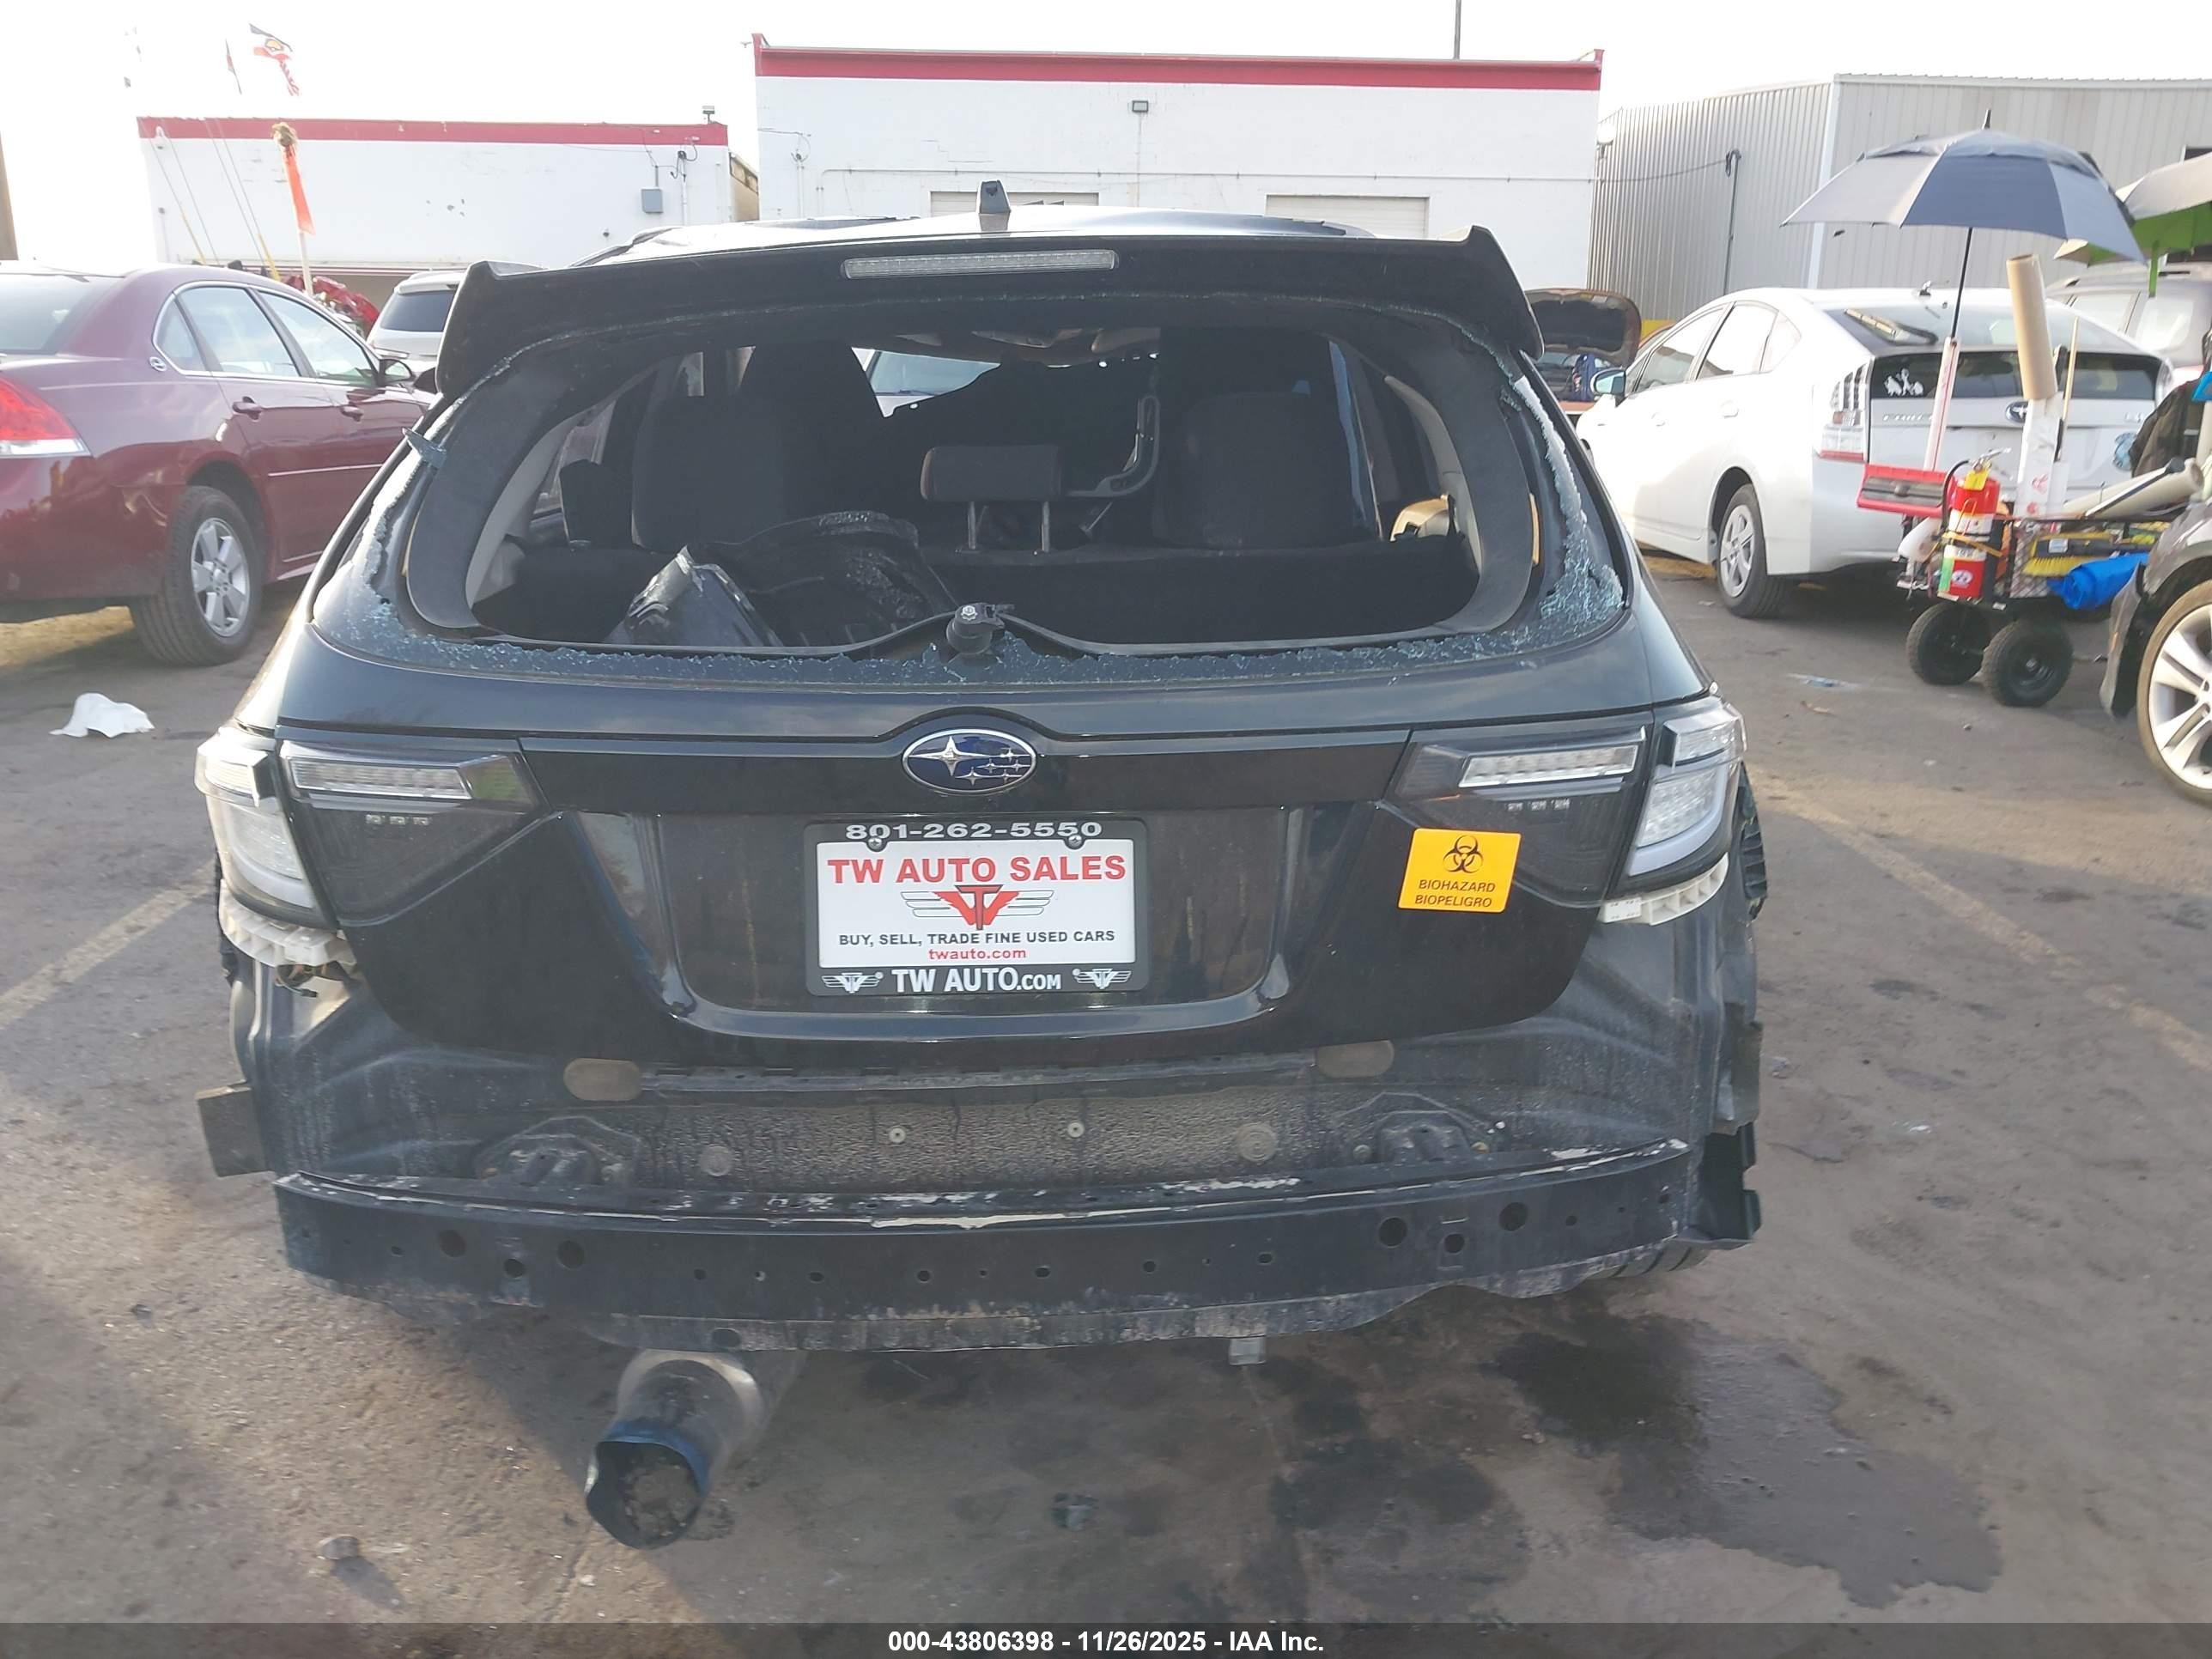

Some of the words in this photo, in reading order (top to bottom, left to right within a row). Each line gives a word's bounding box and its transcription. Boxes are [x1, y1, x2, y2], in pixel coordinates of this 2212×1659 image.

[846, 822, 1103, 840] 801-262-5550
[827, 859, 884, 884] TW
[896, 857, 996, 883] AUTO
[1010, 855, 1126, 882] SALES
[1419, 879, 1496, 893] BIOHAZARD
[1415, 895, 1492, 908] BIOPELIGRO
[839, 934, 873, 947] BUY,
[879, 933, 921, 946] SELL,
[927, 933, 980, 945] TRADE
[985, 933, 1021, 944] FINE
[1027, 932, 1067, 943] USED
[1073, 931, 1115, 942] CARS
[928, 948, 1026, 960] twauto.com
[891, 969, 936, 993] TW
